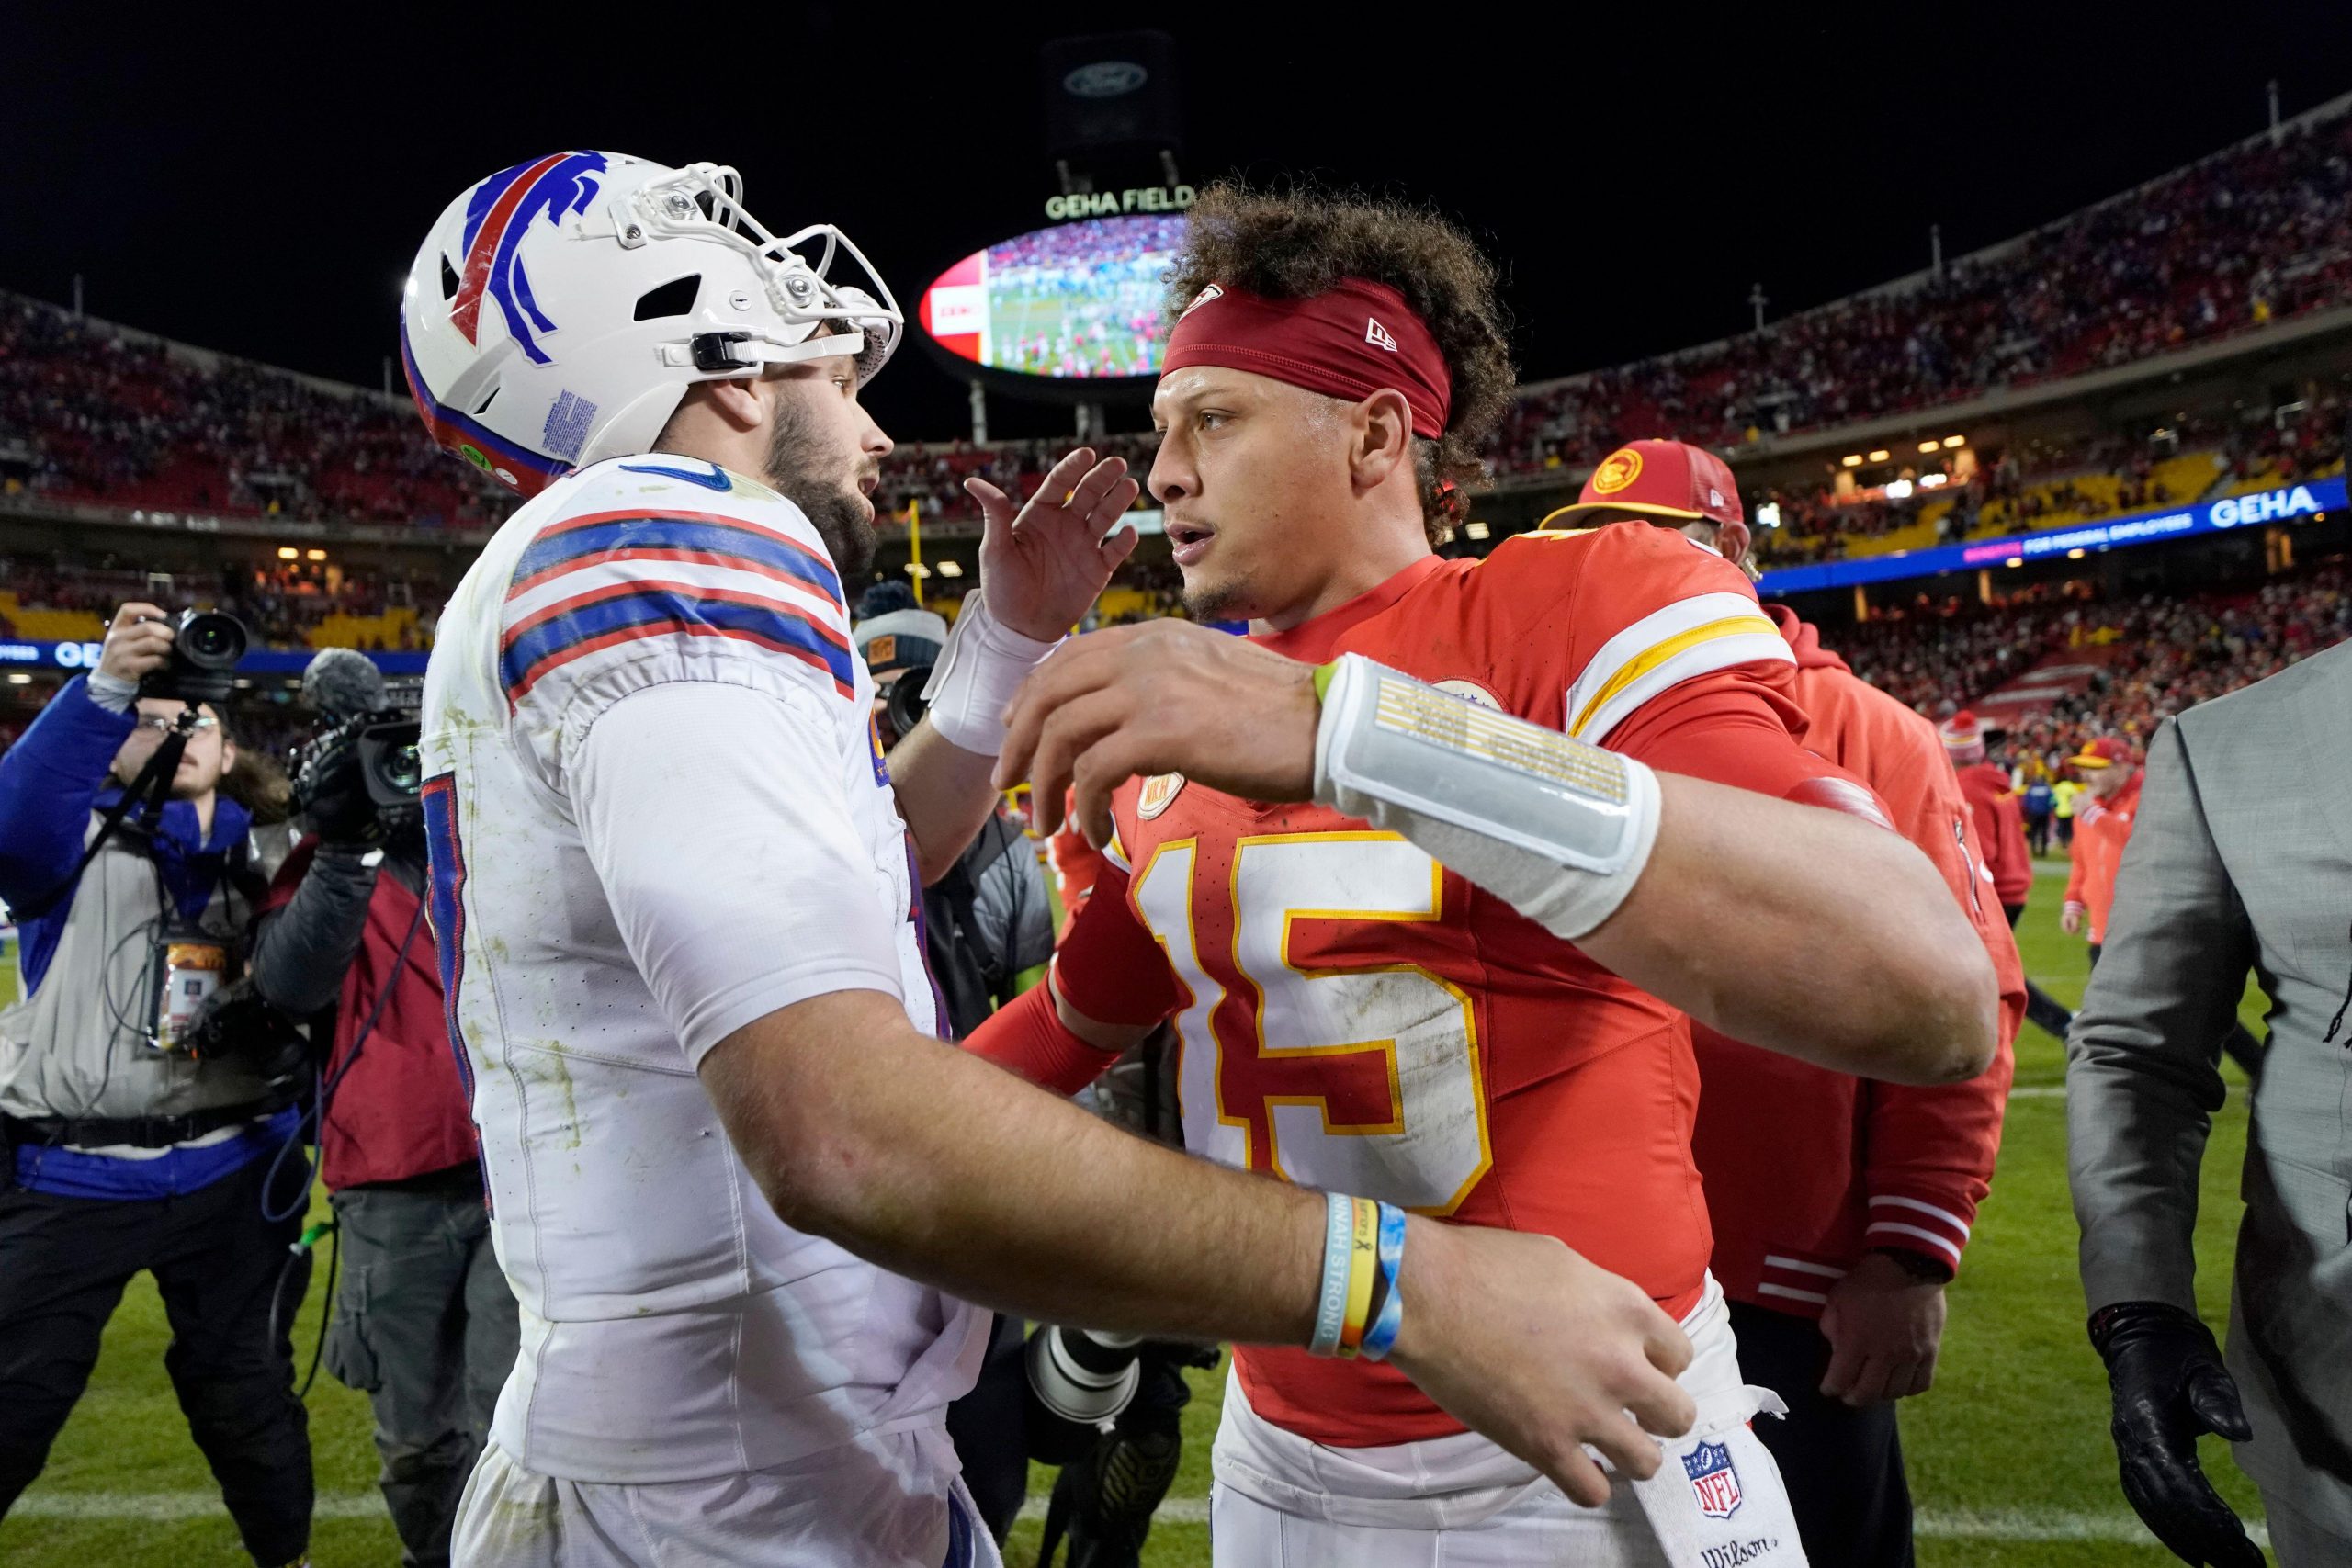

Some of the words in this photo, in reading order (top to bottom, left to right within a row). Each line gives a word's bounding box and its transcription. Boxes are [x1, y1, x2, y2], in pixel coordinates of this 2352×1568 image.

[1045, 191, 1121, 220] GEHA
[1123, 185, 1195, 214] FIELD
[2210, 485, 2319, 529] GEHA
[1133, 830, 1493, 1217] 15
[1320, 1254, 1346, 1339] STRONG
[1694, 1471, 1739, 1512] NFL
[1701, 1537, 1770, 1568] Wilson
